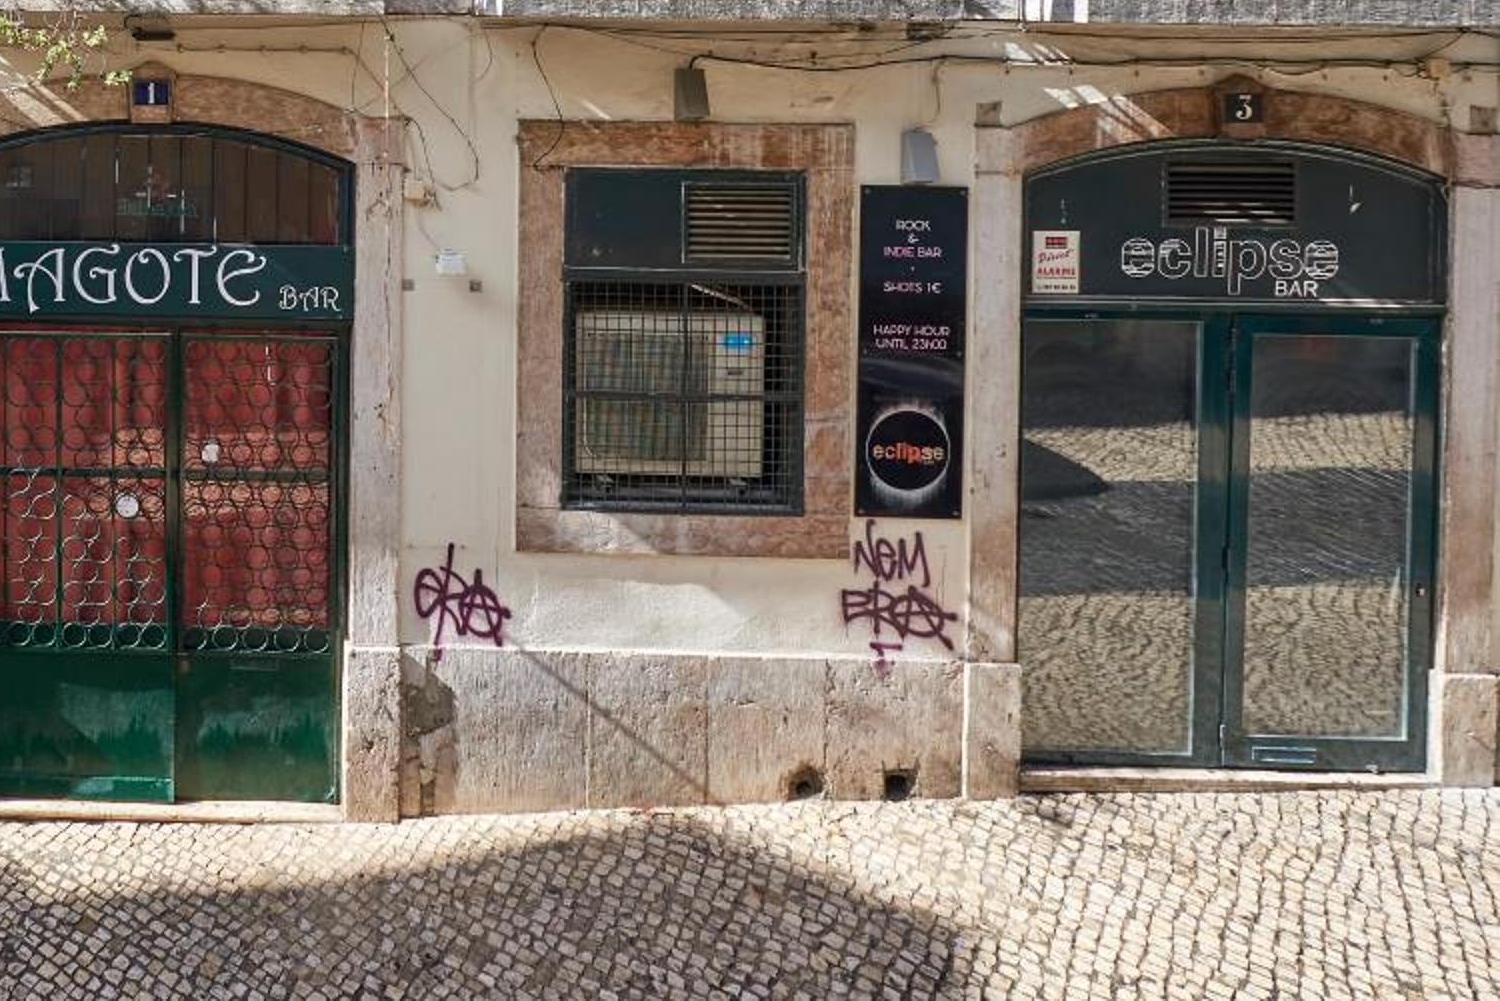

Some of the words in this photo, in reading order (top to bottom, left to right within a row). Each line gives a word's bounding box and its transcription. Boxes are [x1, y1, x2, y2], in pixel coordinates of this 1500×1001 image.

[147, 82, 156, 104] 1
[1235, 94, 1253, 119] 3
[895, 219, 931, 231] ROCK
[907, 232, 919, 244] &
[883, 246, 915, 258] INDIE
[917, 246, 943, 258] BAR
[1121, 226, 1339, 296] eclipse
[883, 281, 923, 293] SHOTS
[927, 282, 942, 294] 1€
[1275, 280, 1319, 297] BAR
[278, 283, 342, 312] BAR
[873, 324, 911, 336] HAPPY
[914, 325, 950, 337] HOUR
[875, 338, 908, 349] UNTIL
[873, 442, 944, 464] eclipse
